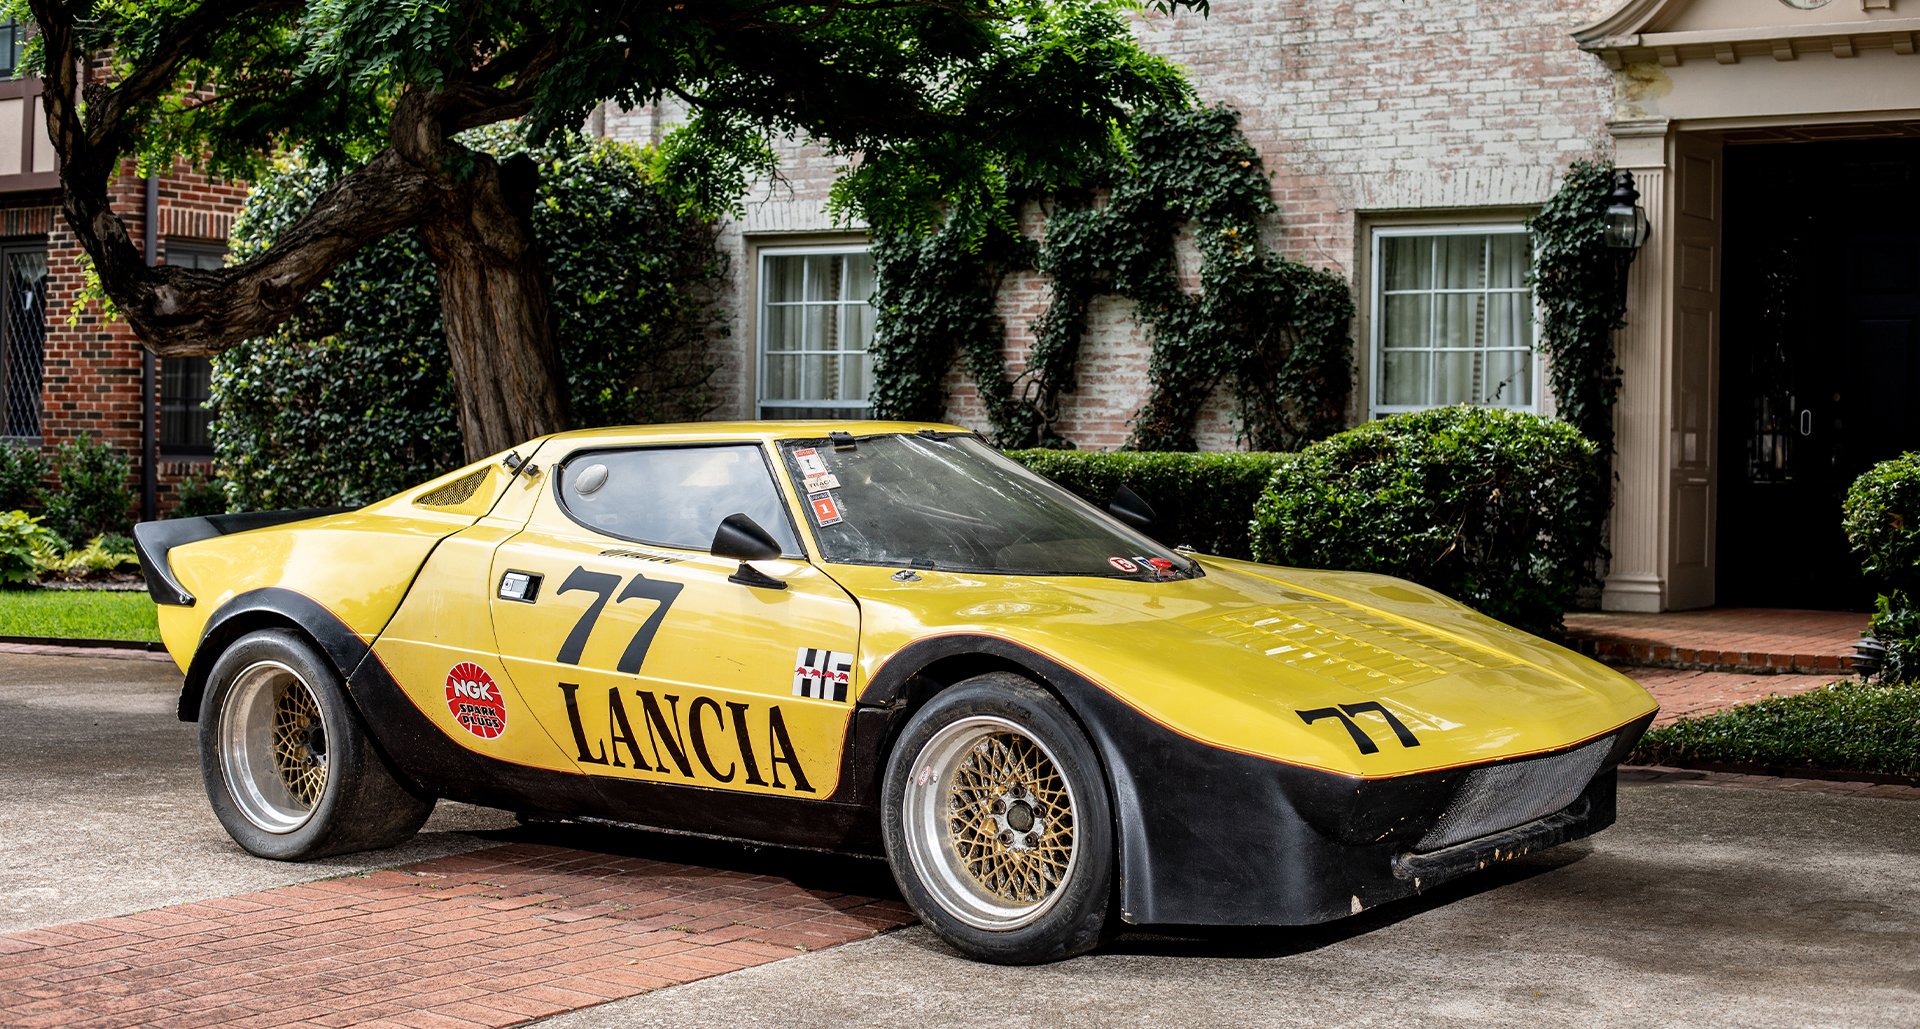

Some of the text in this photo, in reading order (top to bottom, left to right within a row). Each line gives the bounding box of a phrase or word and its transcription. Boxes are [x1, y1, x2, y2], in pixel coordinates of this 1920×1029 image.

[819, 503, 831, 515] 1
[556, 565, 684, 675] 77
[452, 678, 494, 702] NGK
[792, 647, 854, 703] HF
[460, 704, 496, 717] SPARK
[462, 716, 499, 728] PLUGS
[1294, 701, 1421, 756] 77
[558, 681, 817, 794] LANCIA
